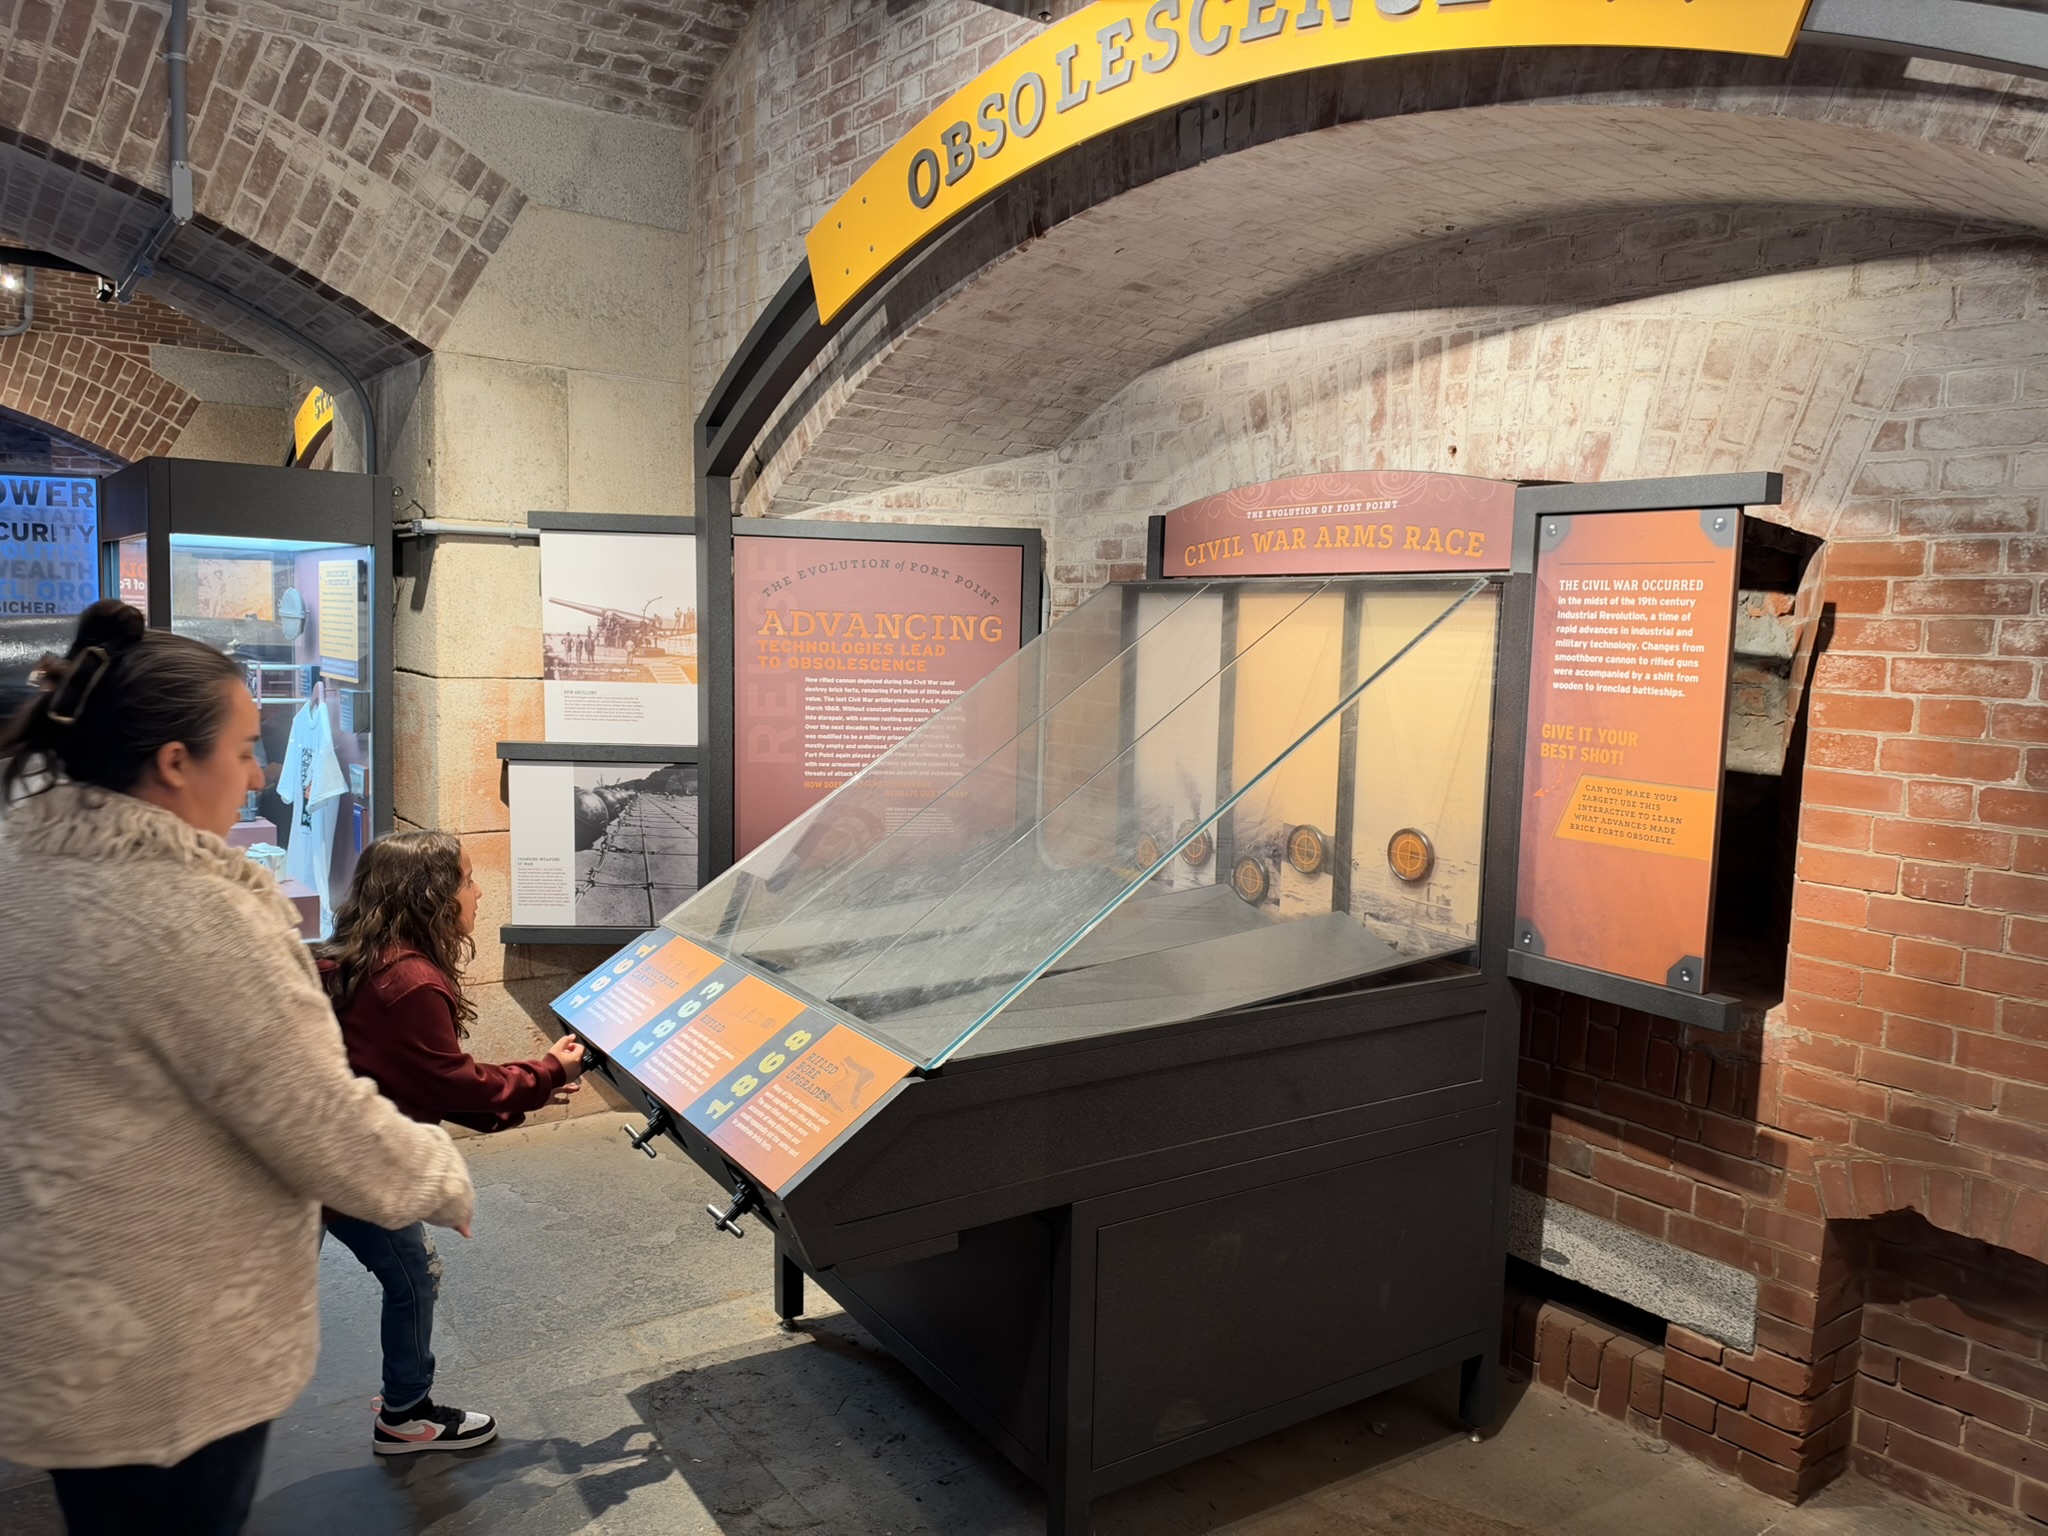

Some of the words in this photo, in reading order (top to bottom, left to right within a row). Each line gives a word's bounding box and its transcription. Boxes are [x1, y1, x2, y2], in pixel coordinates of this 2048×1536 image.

[1246, 511, 1263, 519] THE
[1266, 506, 1318, 518] EVOLUTION
[1321, 505, 1333, 514] OF
[1337, 503, 1362, 513] FORT
[1364, 500, 1398, 510] POINT
[1184, 535, 1244, 568] CIVIL
[1252, 526, 1306, 553] WAR
[1314, 524, 1394, 548] ARMS
[1402, 526, 1486, 558] RACE
[37, 582, 94, 600] ORO
[762, 576, 792, 598] THE
[797, 559, 890, 580] EVOLUTION
[895, 560, 906, 572] of
[910, 562, 950, 580] FORT
[954, 575, 999, 606] POINT
[1559, 580, 1579, 591] THE
[1582, 580, 1611, 591] CIVIL
[1613, 580, 1639, 591] WAR
[1642, 579, 1704, 591] OCCURRED
[1558, 596, 1566, 605] in
[1568, 596, 1582, 605] the
[1584, 596, 1608, 606] midst
[1610, 596, 1619, 605] of
[1621, 597, 1636, 606] the
[1638, 596, 1658, 606] 19th
[1659, 597, 1696, 608] century
[1557, 610, 1598, 620] Industrial
[1599, 611, 1648, 622] Revolution,
[1658, 612, 1680, 621] time
[1681, 612, 1692, 621] of
[758, 609, 1002, 643] ADVANCING
[1556, 624, 1578, 635] rapid
[1579, 625, 1619, 635] advances
[1620, 626, 1629, 635] in
[1631, 626, 1674, 636] industrial
[1676, 628, 1694, 637] and
[758, 639, 894, 656] TECHNOLOGIES
[901, 643, 946, 657] LEAD
[1555, 639, 1588, 650] military
[1590, 640, 1640, 652] technology.
[1641, 641, 1680, 653] Changes
[1682, 642, 1705, 652] from
[759, 655, 782, 669] TO
[788, 657, 926, 673] OBSOLESCENCE
[1554, 653, 1604, 663] smoothbore
[1605, 656, 1637, 665] cannon
[1638, 656, 1649, 665] to
[1650, 656, 1675, 666] rifled
[1676, 660, 1699, 669] guns
[1575, 669, 1630, 679] accompanied
[1632, 670, 1643, 682] by
[1653, 672, 1674, 682] shift
[1676, 673, 1699, 683] from
[1553, 682, 1584, 691] wooden
[1585, 682, 1595, 691] to
[1596, 683, 1631, 694] ironclad
[1632, 685, 1686, 698] battleships.
[1542, 724, 1575, 741] GIVE
[1578, 727, 1593, 743] IT
[1598, 729, 1639, 748] YOUR
[1541, 743, 1576, 760] BEST
[1581, 747, 1625, 766] SHOT!
[1582, 794, 1618, 805] TARGET?
[1620, 799, 1637, 808] USE
[1639, 802, 1661, 811] THIS
[1585, 784, 1604, 793] CAN
[1605, 787, 1623, 796] YOU
[1625, 789, 1651, 799] MAKE
[1654, 793, 1678, 803] YOUR
[1574, 813, 1599, 823] WHAT
[1600, 817, 1647, 831] ADVANCES
[1649, 824, 1676, 835] MADE
[1578, 804, 1636, 818] INTERACTIVE
[1638, 812, 1650, 820] TO
[1652, 814, 1683, 825] LEARN
[1570, 823, 1595, 833] BRICK
[1597, 827, 1624, 838] FORTS
[1627, 832, 1675, 846] OBSOLETE.
[569, 944, 657, 1008] 1861
[629, 982, 724, 1057] 1863
[700, 1014, 726, 1033] RIFLED
[796, 1062, 822, 1080] BORE
[805, 1052, 839, 1075] RIFLED
[705, 1030, 812, 1119] 1868
[786, 1070, 831, 1102] UPGRADES
